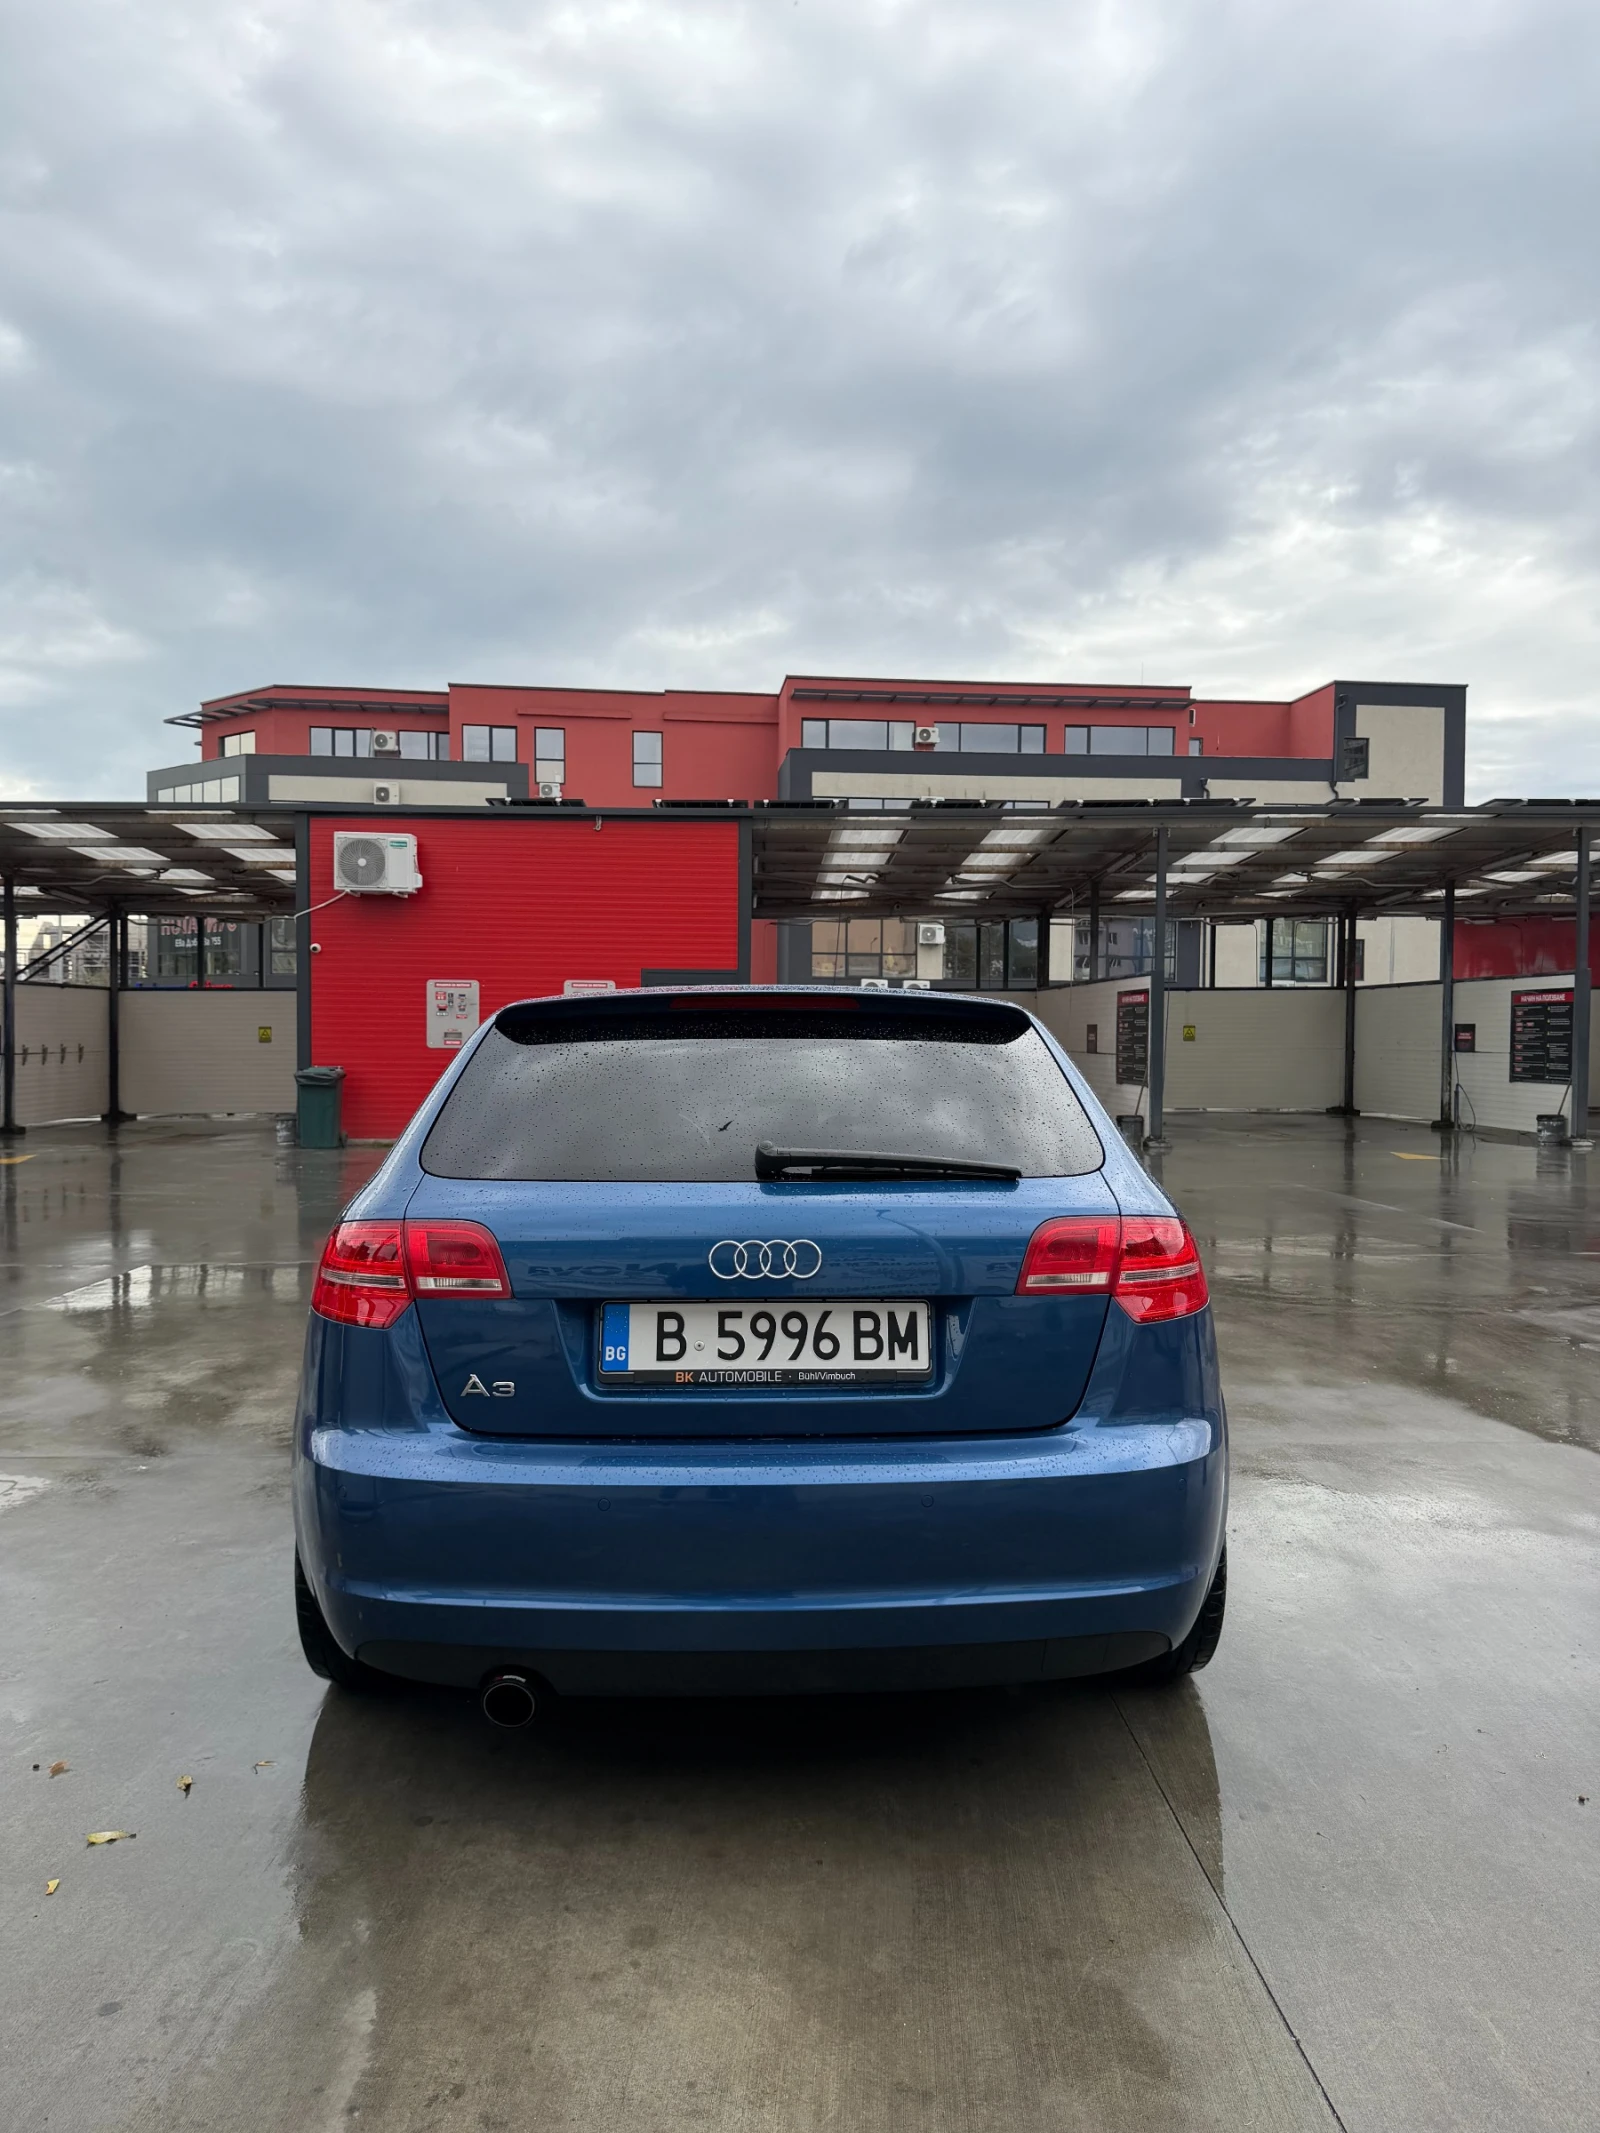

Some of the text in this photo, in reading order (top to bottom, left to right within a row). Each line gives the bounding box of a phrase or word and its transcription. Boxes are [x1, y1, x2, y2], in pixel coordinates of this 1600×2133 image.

[656, 1311, 918, 1361] B 5996 BM
[605, 1346, 626, 1361] BG
[460, 1373, 515, 1397] A3
[675, 1371, 856, 1383] BK AUTOMOBILE Bühl/Vimbuch
